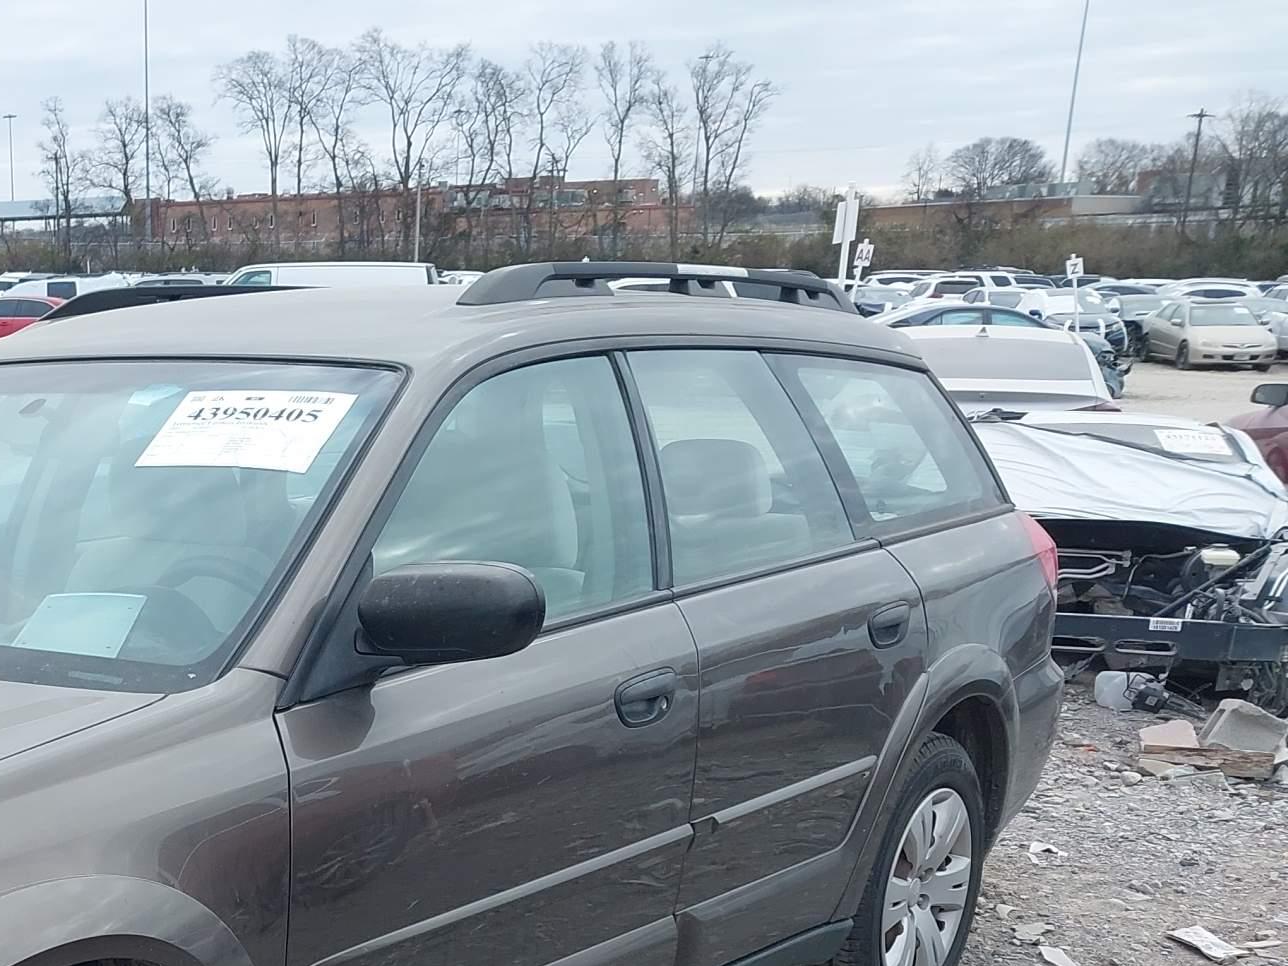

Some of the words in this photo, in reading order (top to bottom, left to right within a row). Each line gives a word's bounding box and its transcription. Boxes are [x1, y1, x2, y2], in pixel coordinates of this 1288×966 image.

[855, 248, 871, 262] AA
[1070, 262, 1080, 275] Z
[186, 406, 324, 423] 43950405
